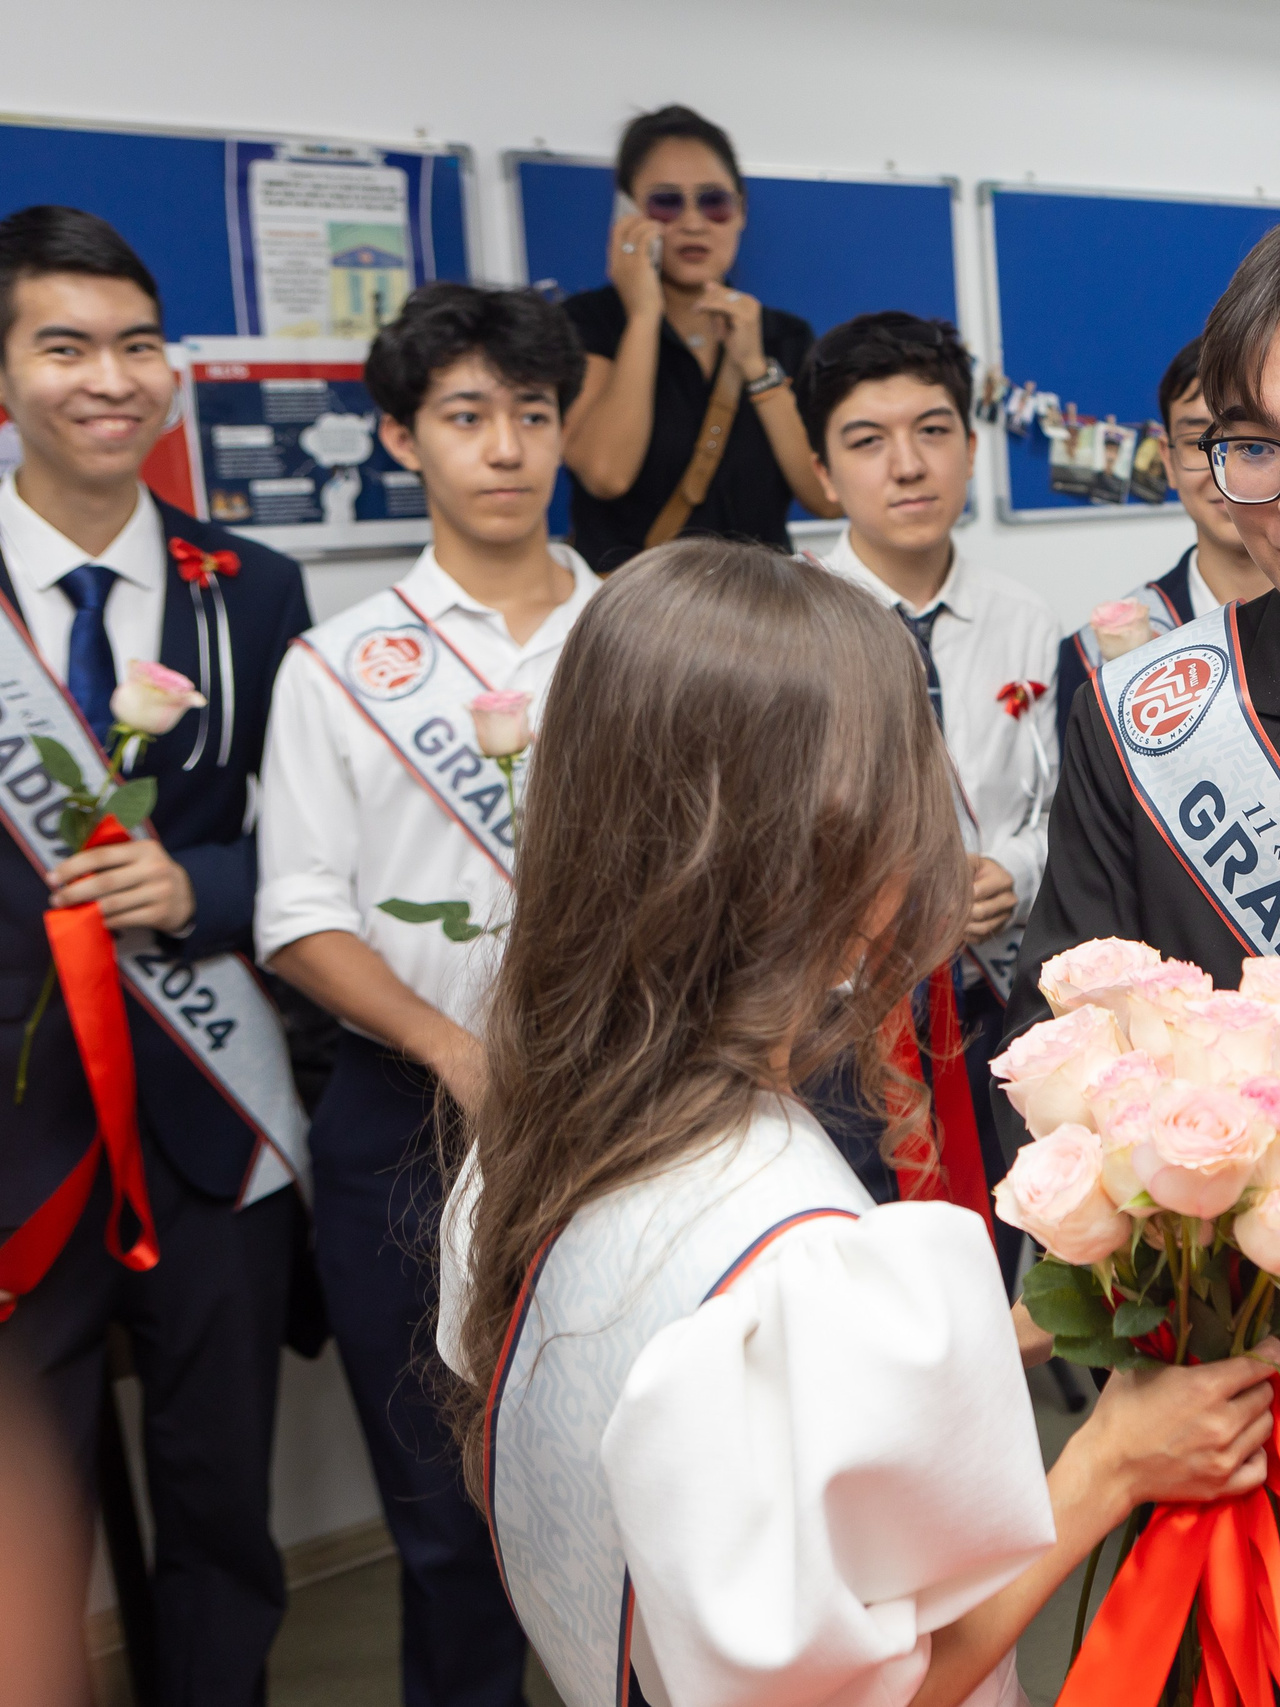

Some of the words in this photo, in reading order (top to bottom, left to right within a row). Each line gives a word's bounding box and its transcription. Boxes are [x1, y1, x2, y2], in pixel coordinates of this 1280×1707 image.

[1125, 710, 1150, 745] PHYSICS
[1170, 715, 1195, 740] MATH
[1241, 801, 1278, 838] 11
